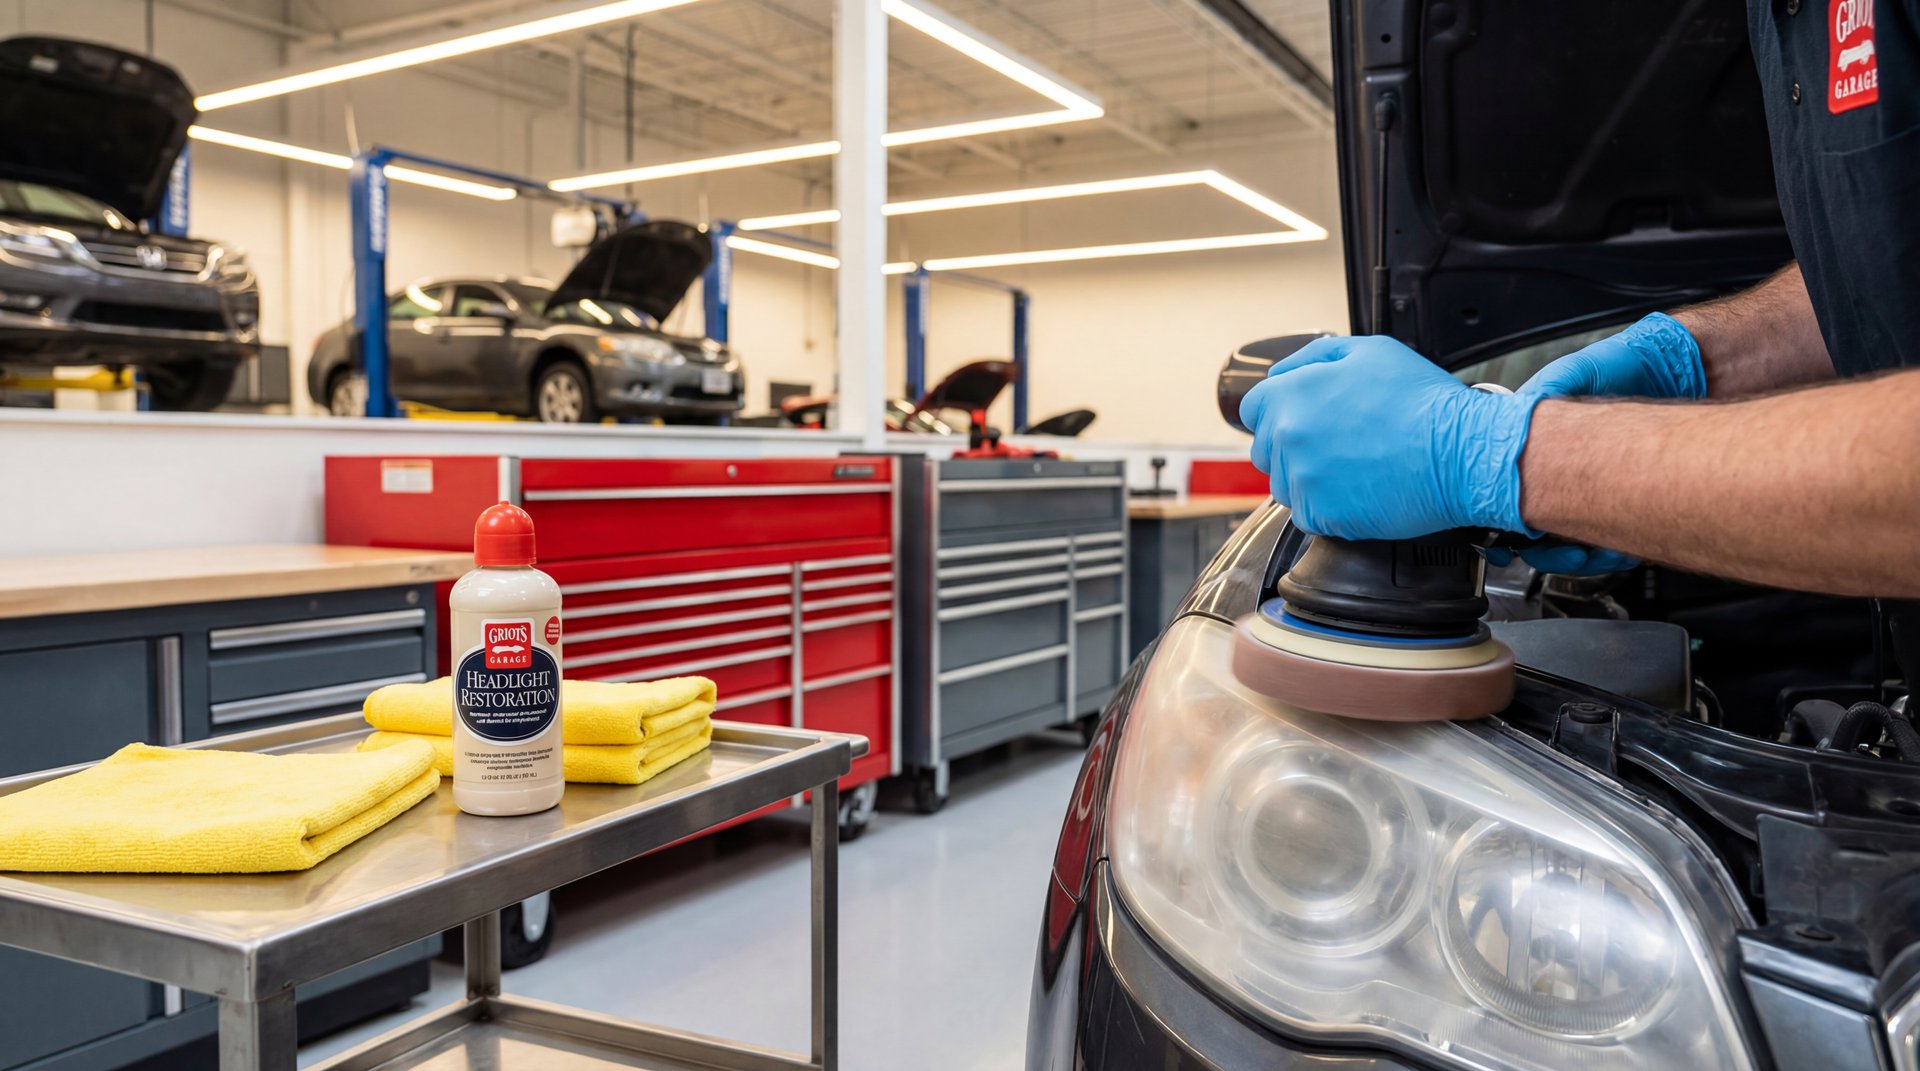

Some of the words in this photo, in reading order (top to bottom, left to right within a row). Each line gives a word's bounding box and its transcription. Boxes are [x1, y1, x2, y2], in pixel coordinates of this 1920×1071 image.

[1835, 68, 1878, 99] GARAGE
[490, 655, 527, 664] GARAGE
[466, 670, 551, 689] HEADLIGHT
[461, 688, 555, 708] RESTORATION
